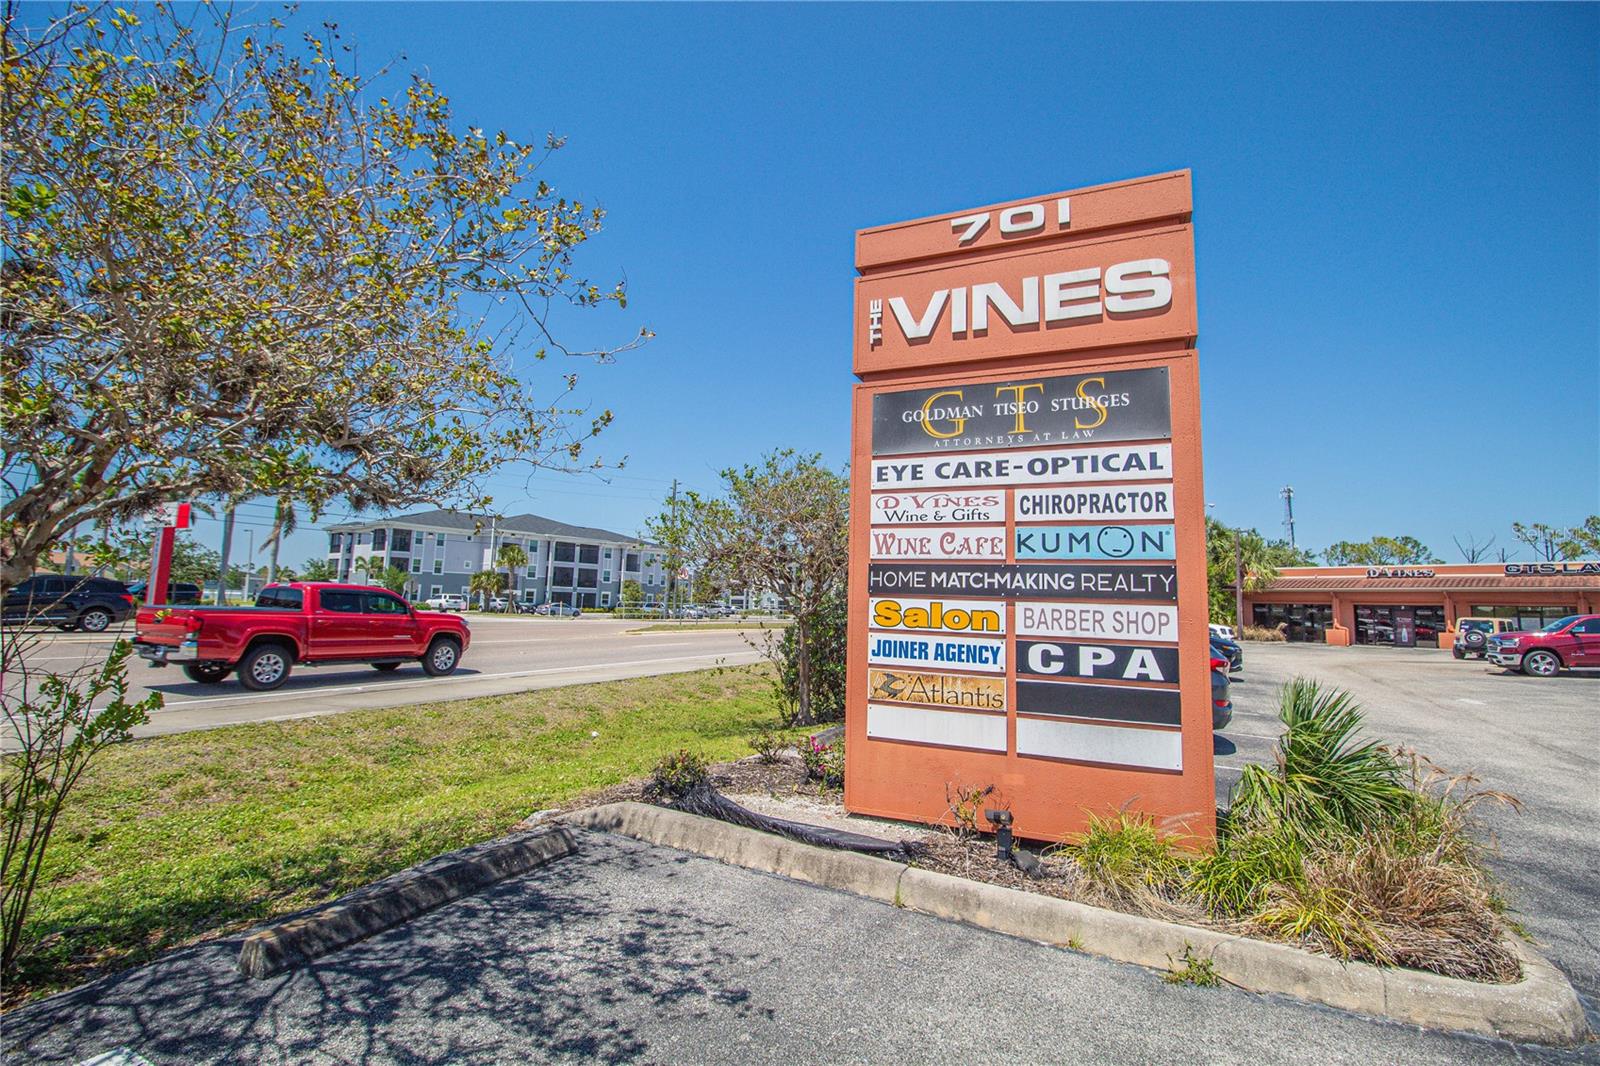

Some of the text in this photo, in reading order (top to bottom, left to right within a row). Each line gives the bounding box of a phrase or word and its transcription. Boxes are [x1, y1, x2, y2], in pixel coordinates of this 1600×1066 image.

[951, 198, 1070, 242] 701
[888, 258, 1172, 340] VINES
[870, 299, 882, 344] THE
[902, 393, 1130, 423] GOLDMAN TISEO STURGES
[934, 429, 1094, 448] ATTORNEYS AT LAW
[876, 452, 1164, 483] EYE CARE-OPTICAL
[884, 508, 990, 522] Wine & Gifts
[1020, 491, 1168, 515] CHIROPRACTOR
[873, 532, 1003, 556] WINE CAFE
[871, 571, 1175, 593] HOME MATCHMAKING REALTY
[1505, 563, 1557, 575] GTS
[873, 600, 1000, 632] Salon
[1024, 607, 1170, 635] BARBER SHOP
[872, 639, 1001, 665] JOINER AGENCY
[1027, 643, 1165, 681] CPA
[906, 676, 1004, 709] Atlantis
